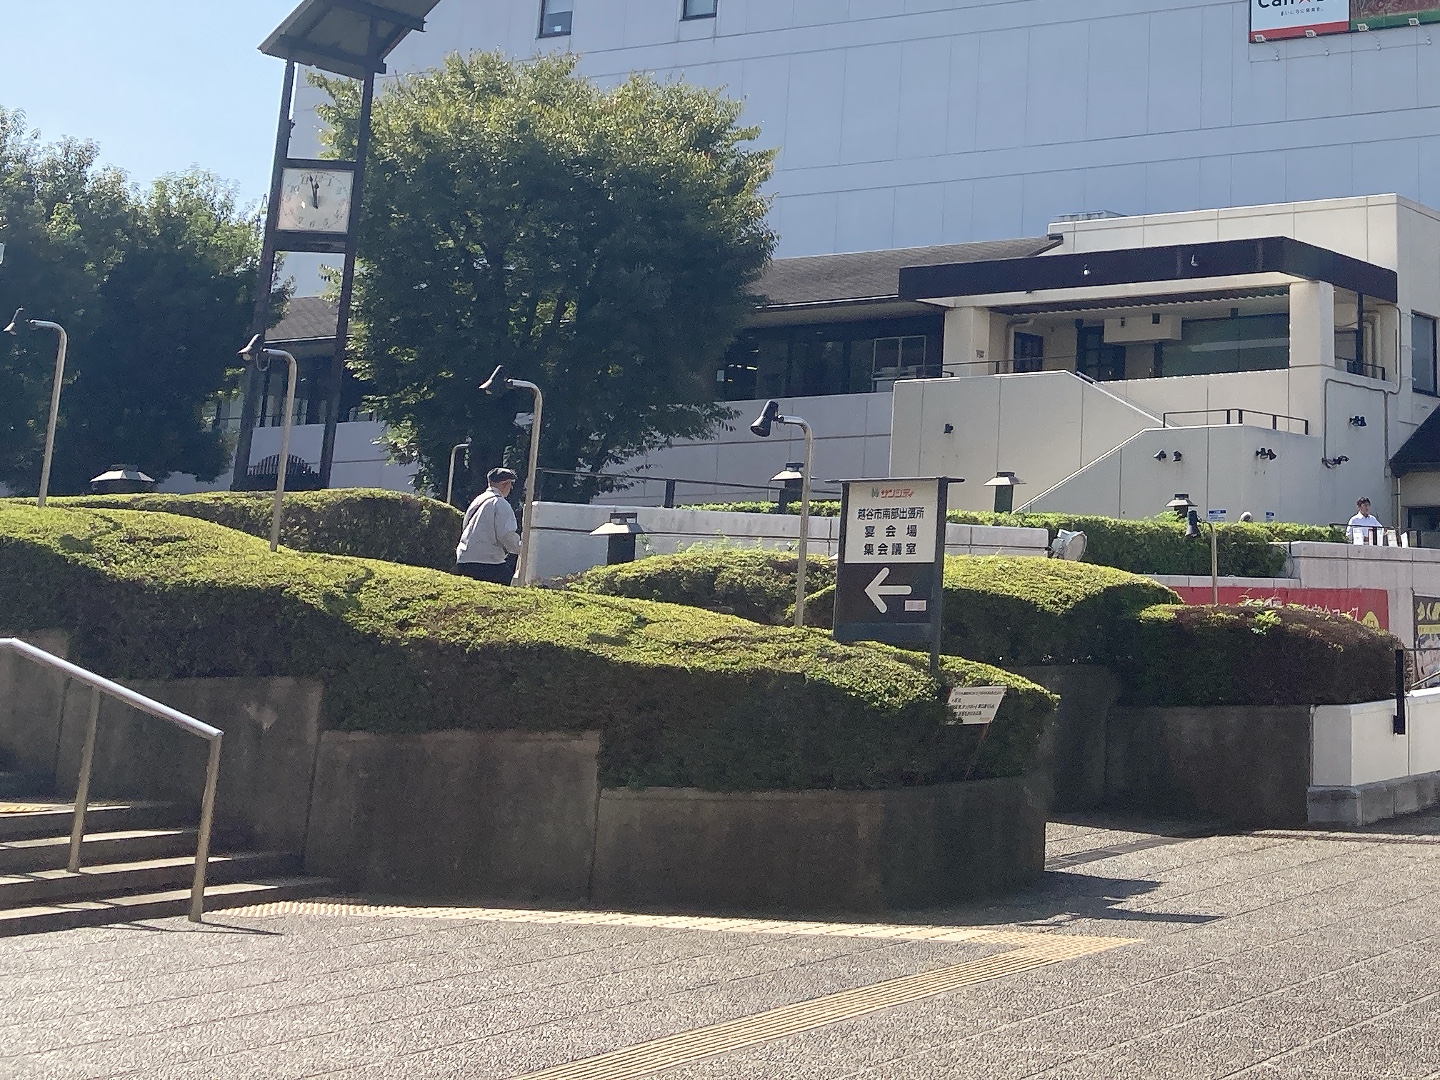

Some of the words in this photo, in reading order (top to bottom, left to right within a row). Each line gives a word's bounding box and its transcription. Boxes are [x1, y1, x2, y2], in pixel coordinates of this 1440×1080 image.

[857, 507, 925, 520] 越谷市南部出張所
